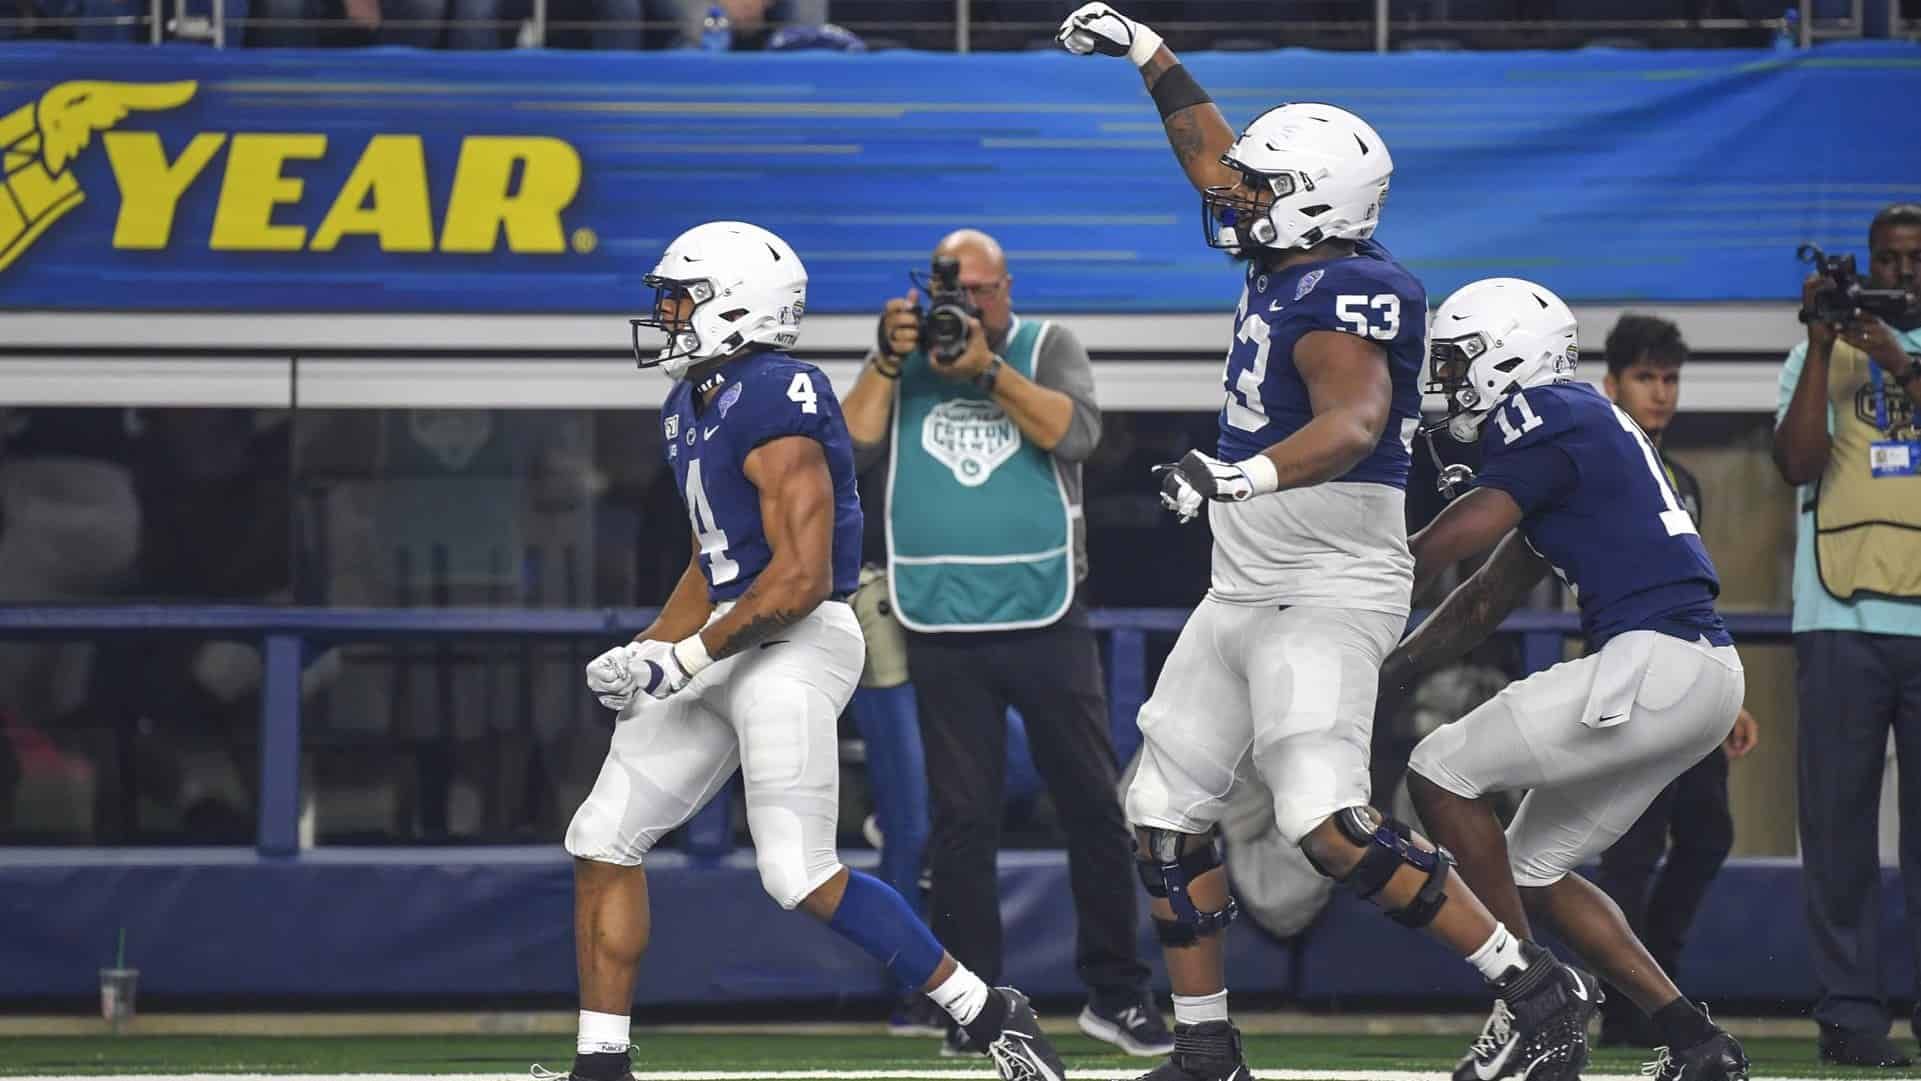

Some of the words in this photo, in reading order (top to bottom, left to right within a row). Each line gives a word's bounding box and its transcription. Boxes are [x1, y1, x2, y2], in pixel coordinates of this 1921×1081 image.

[103, 132, 582, 254] YEAR
[1223, 281, 1271, 433] 3
[1335, 294, 1400, 341] 53
[787, 372, 818, 414] 4
[934, 421, 1010, 445] COTTON
[1494, 391, 1544, 446] 11
[1611, 404, 1700, 537] 1
[686, 458, 740, 586] 4
